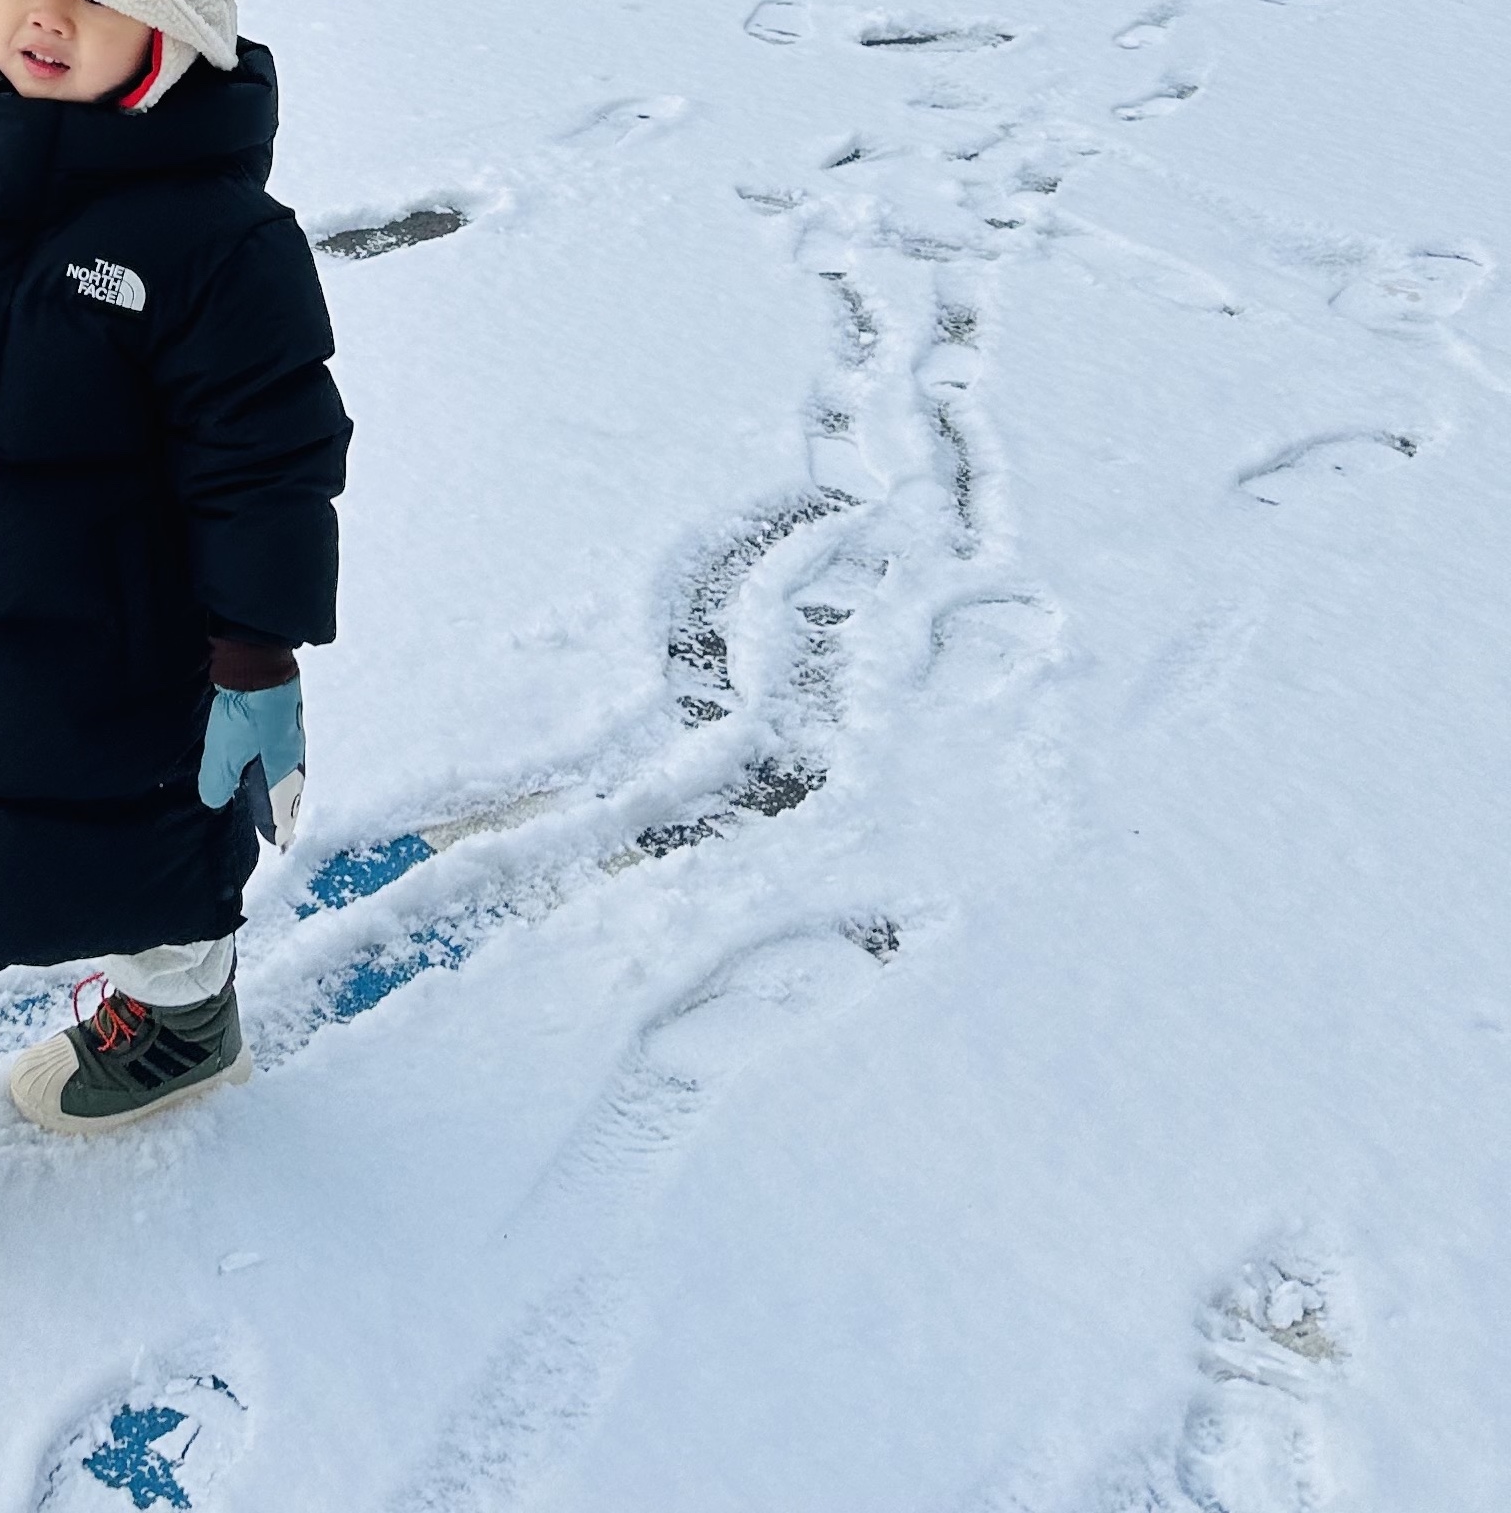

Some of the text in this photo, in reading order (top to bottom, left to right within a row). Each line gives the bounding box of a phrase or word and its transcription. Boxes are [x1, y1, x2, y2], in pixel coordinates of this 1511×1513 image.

[66, 263, 122, 292] NORTH
[94, 257, 126, 279] THE
[77, 280, 118, 305] FACE
